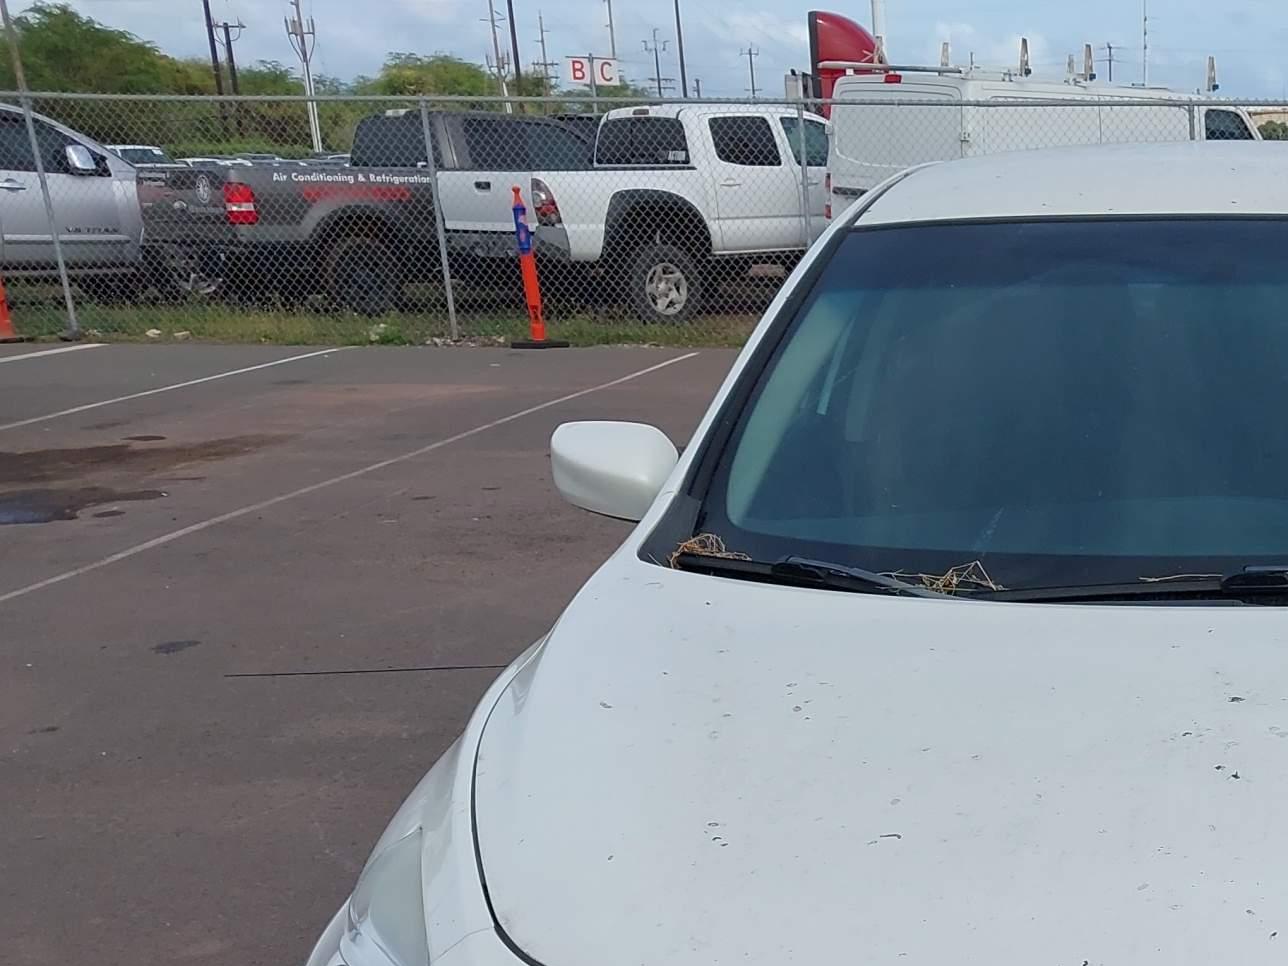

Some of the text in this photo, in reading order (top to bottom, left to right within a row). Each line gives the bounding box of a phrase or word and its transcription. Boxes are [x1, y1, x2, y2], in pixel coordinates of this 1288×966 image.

[572, 60, 586, 81] B
[600, 61, 614, 82] C
[272, 172, 288, 182] Air
[291, 172, 355, 184] Conditioning
[357, 173, 366, 182] &
